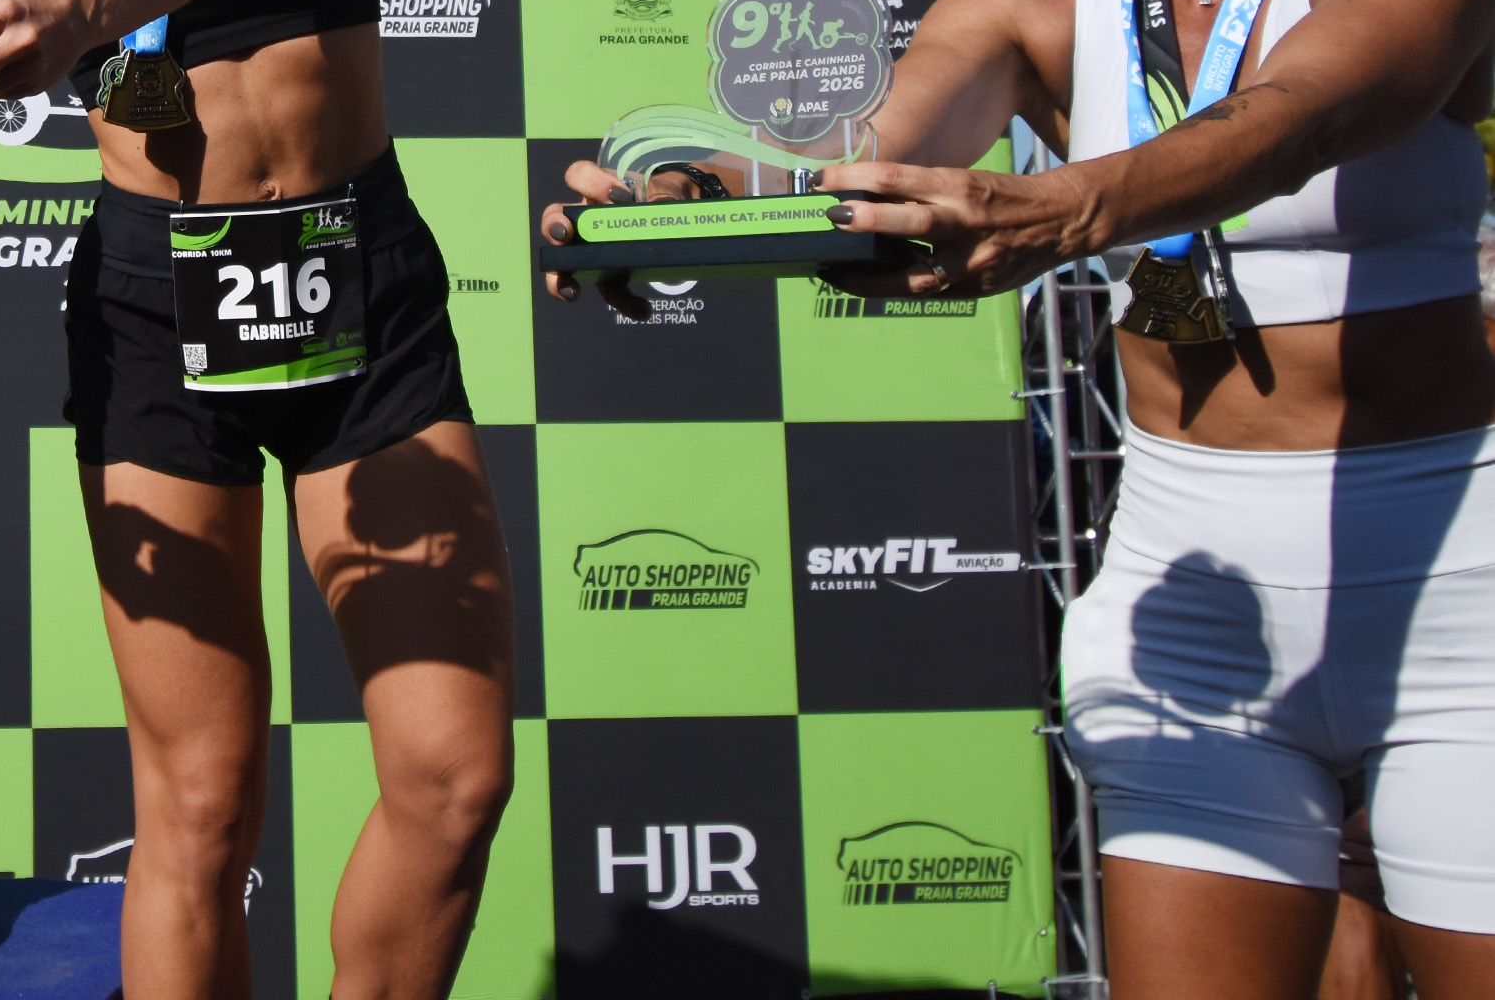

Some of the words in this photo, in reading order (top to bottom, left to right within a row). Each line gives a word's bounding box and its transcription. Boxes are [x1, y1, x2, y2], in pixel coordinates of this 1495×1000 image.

[384, 21, 421, 33] PRAIA
[424, 22, 474, 34] GRANDE
[600, 36, 636, 44] PRAIA
[639, 36, 689, 44] GRANDE
[749, 60, 792, 71] CORRIDA
[805, 54, 865, 66] CAMINHADA
[1204, 44, 1227, 90] CIRCUITO
[1215, 48, 1237, 92] INTEGRA
[733, 73, 766, 85] APAE
[770, 69, 808, 81] PRAIA
[813, 64, 865, 78] GRANDE
[819, 76, 864, 93] 2026
[797, 101, 829, 113] APAE
[607, 218, 647, 229] LUGAR
[650, 215, 691, 227] GERAL
[694, 213, 726, 224] 10KM
[729, 212, 758, 222] CAT.
[761, 208, 826, 220] FEMININO
[172, 250, 207, 259] CORRIDA
[211, 249, 232, 257] 10KM
[218, 257, 330, 320] 216
[457, 280, 499, 291] Filho
[884, 301, 922, 314] PRAIA
[924, 301, 974, 314] GRANDE
[665, 314, 697, 324] PRAIA
[239, 320, 315, 341] GABRIELLE
[807, 538, 957, 575] SKYFIT
[955, 556, 1004, 571] AVIAÇÃO
[583, 564, 638, 588] AUTO
[645, 564, 752, 587] SHOPPING
[810, 580, 877, 591] ACADEMIA
[651, 593, 692, 606] PRAIA
[692, 592, 744, 606] GRANDE
[597, 824, 758, 910] HJR
[845, 859, 904, 882] AUTO
[908, 856, 1014, 881] SHOPPING
[689, 893, 759, 907] SPORTS
[914, 887, 954, 900] PRAIA
[955, 885, 1007, 899] GRANDE
